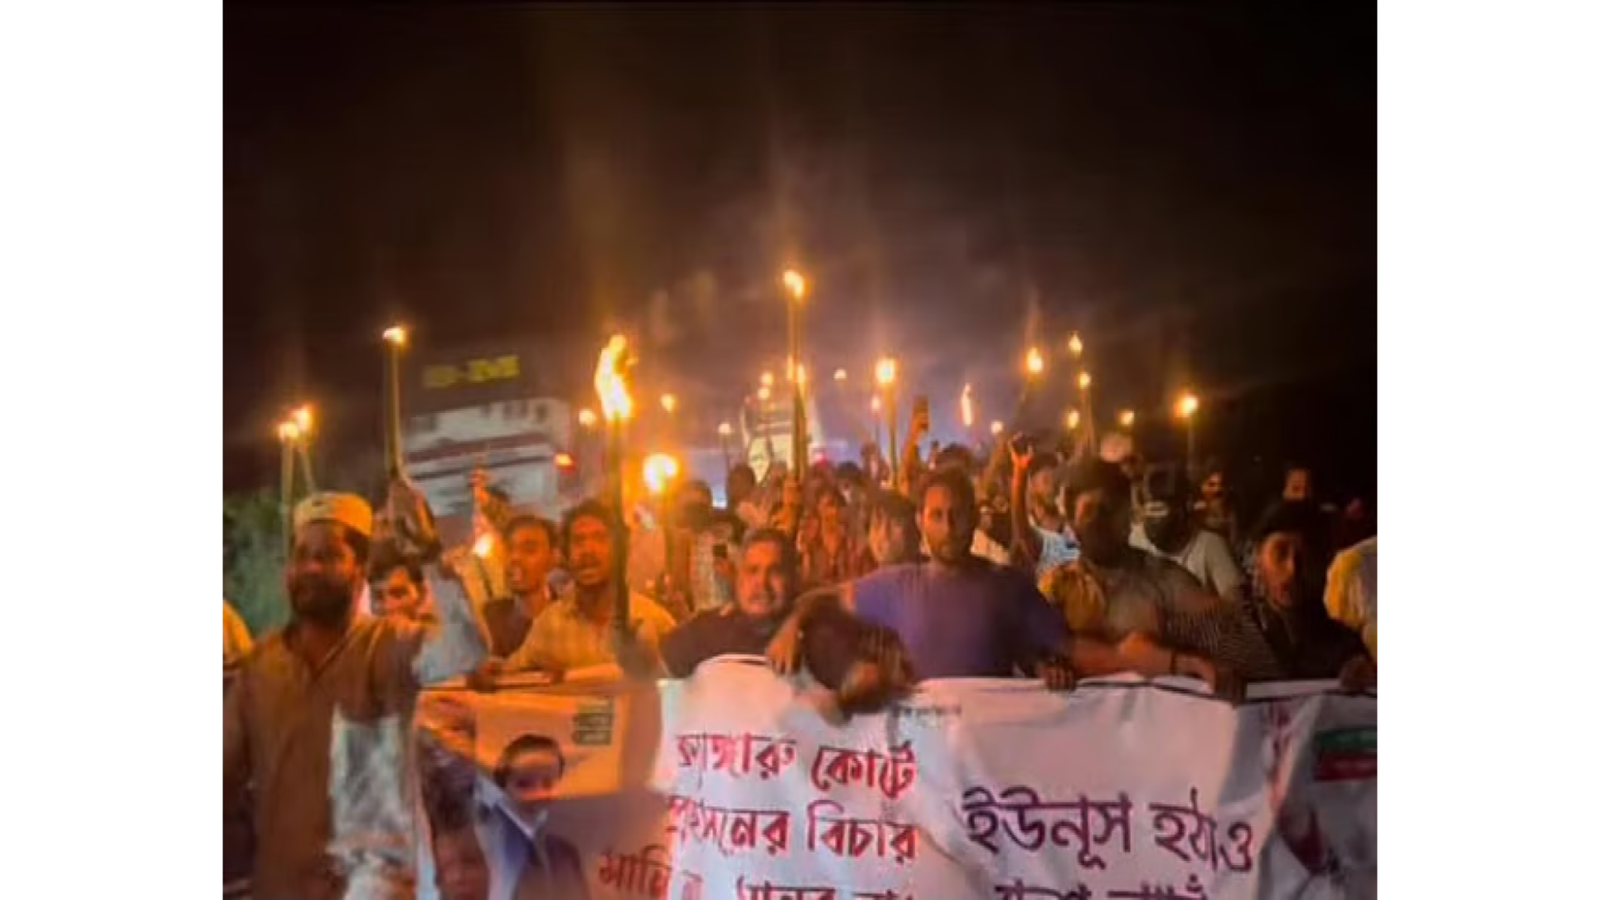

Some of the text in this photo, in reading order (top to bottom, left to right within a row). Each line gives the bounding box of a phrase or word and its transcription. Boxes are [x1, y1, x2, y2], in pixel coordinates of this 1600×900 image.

[811, 738, 917, 799] কোর্টে
[807, 799, 919, 864] বিচার
[960, 786, 1253, 872] ইউনূস হঠাও
